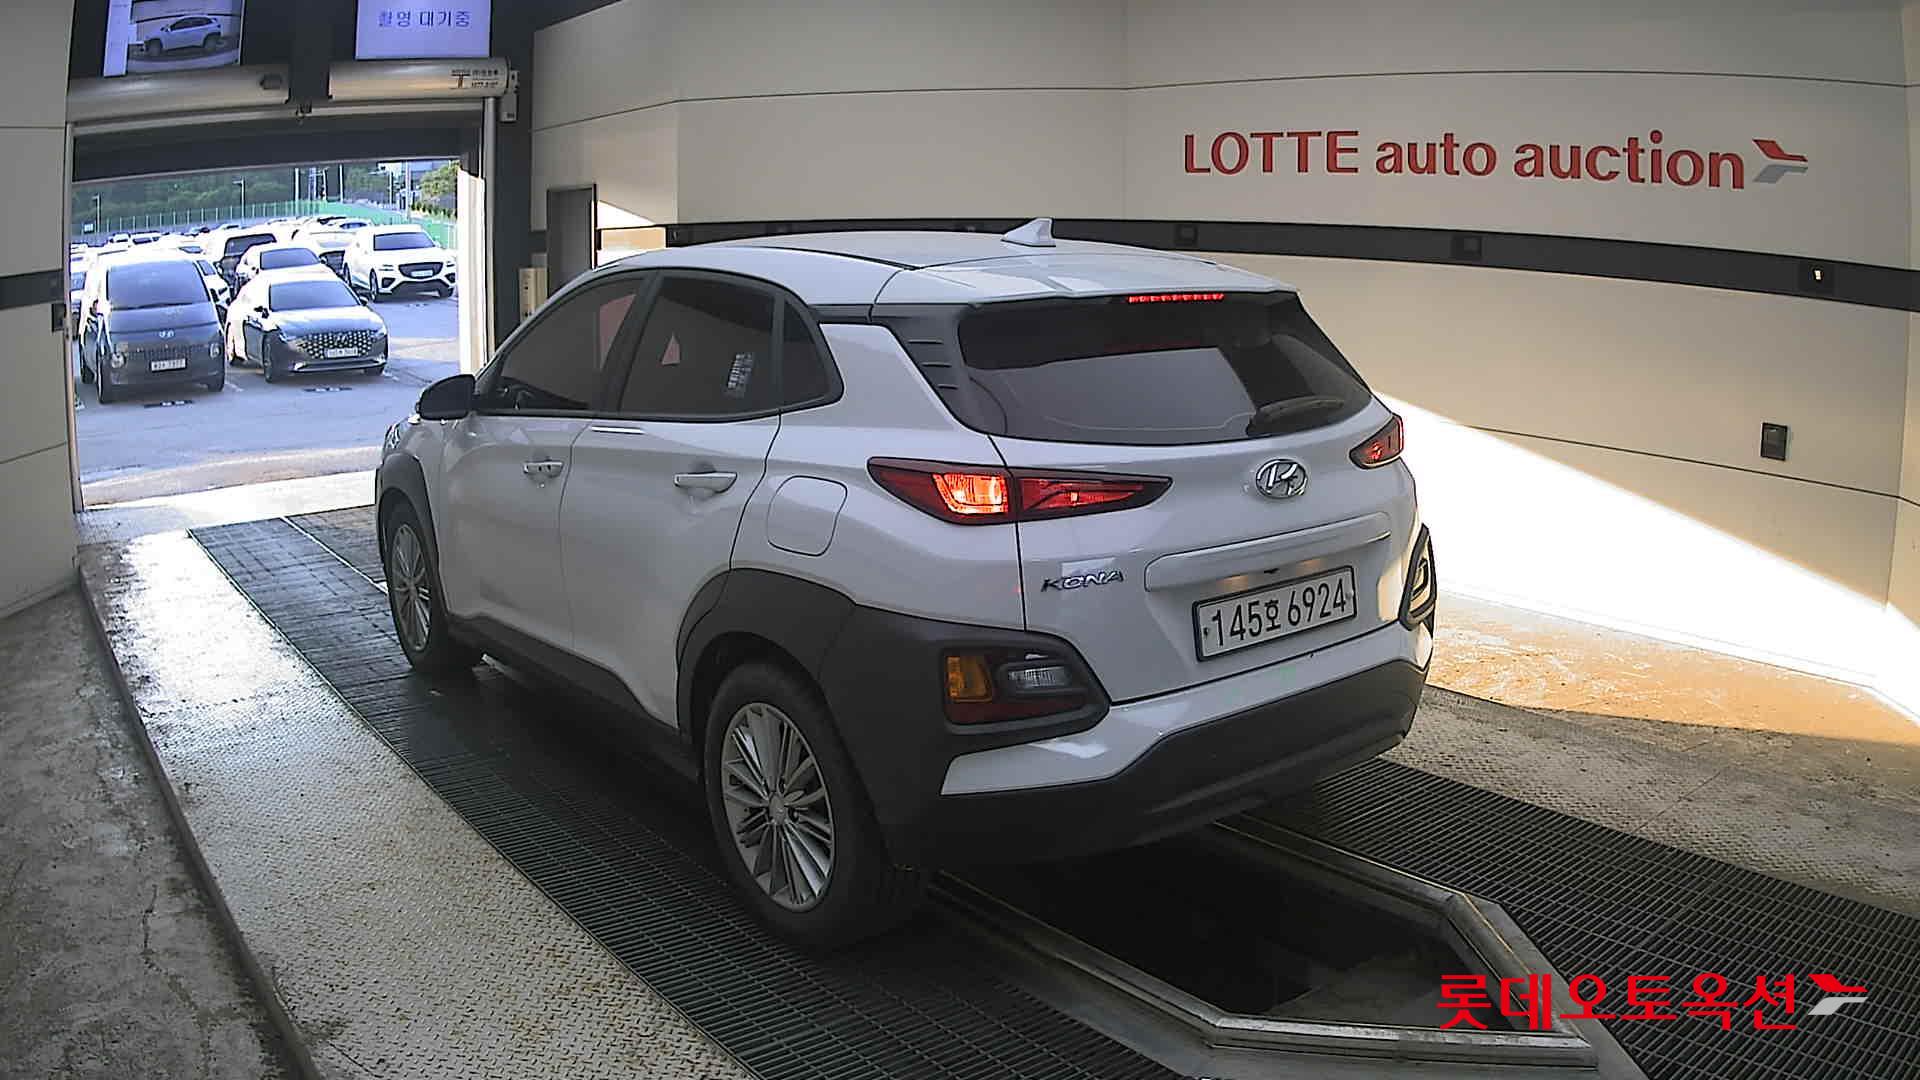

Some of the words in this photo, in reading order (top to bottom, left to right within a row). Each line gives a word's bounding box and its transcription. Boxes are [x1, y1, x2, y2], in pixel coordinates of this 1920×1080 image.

[418, 10, 471, 28] 대기중
[1184, 131, 1359, 174] LOTTE
[1376, 132, 1497, 176] auto
[1514, 130, 1745, 189] auction
[1040, 570, 1124, 592] KONA
[1211, 600, 1281, 647] 145호
[1287, 577, 1347, 627] 6924
